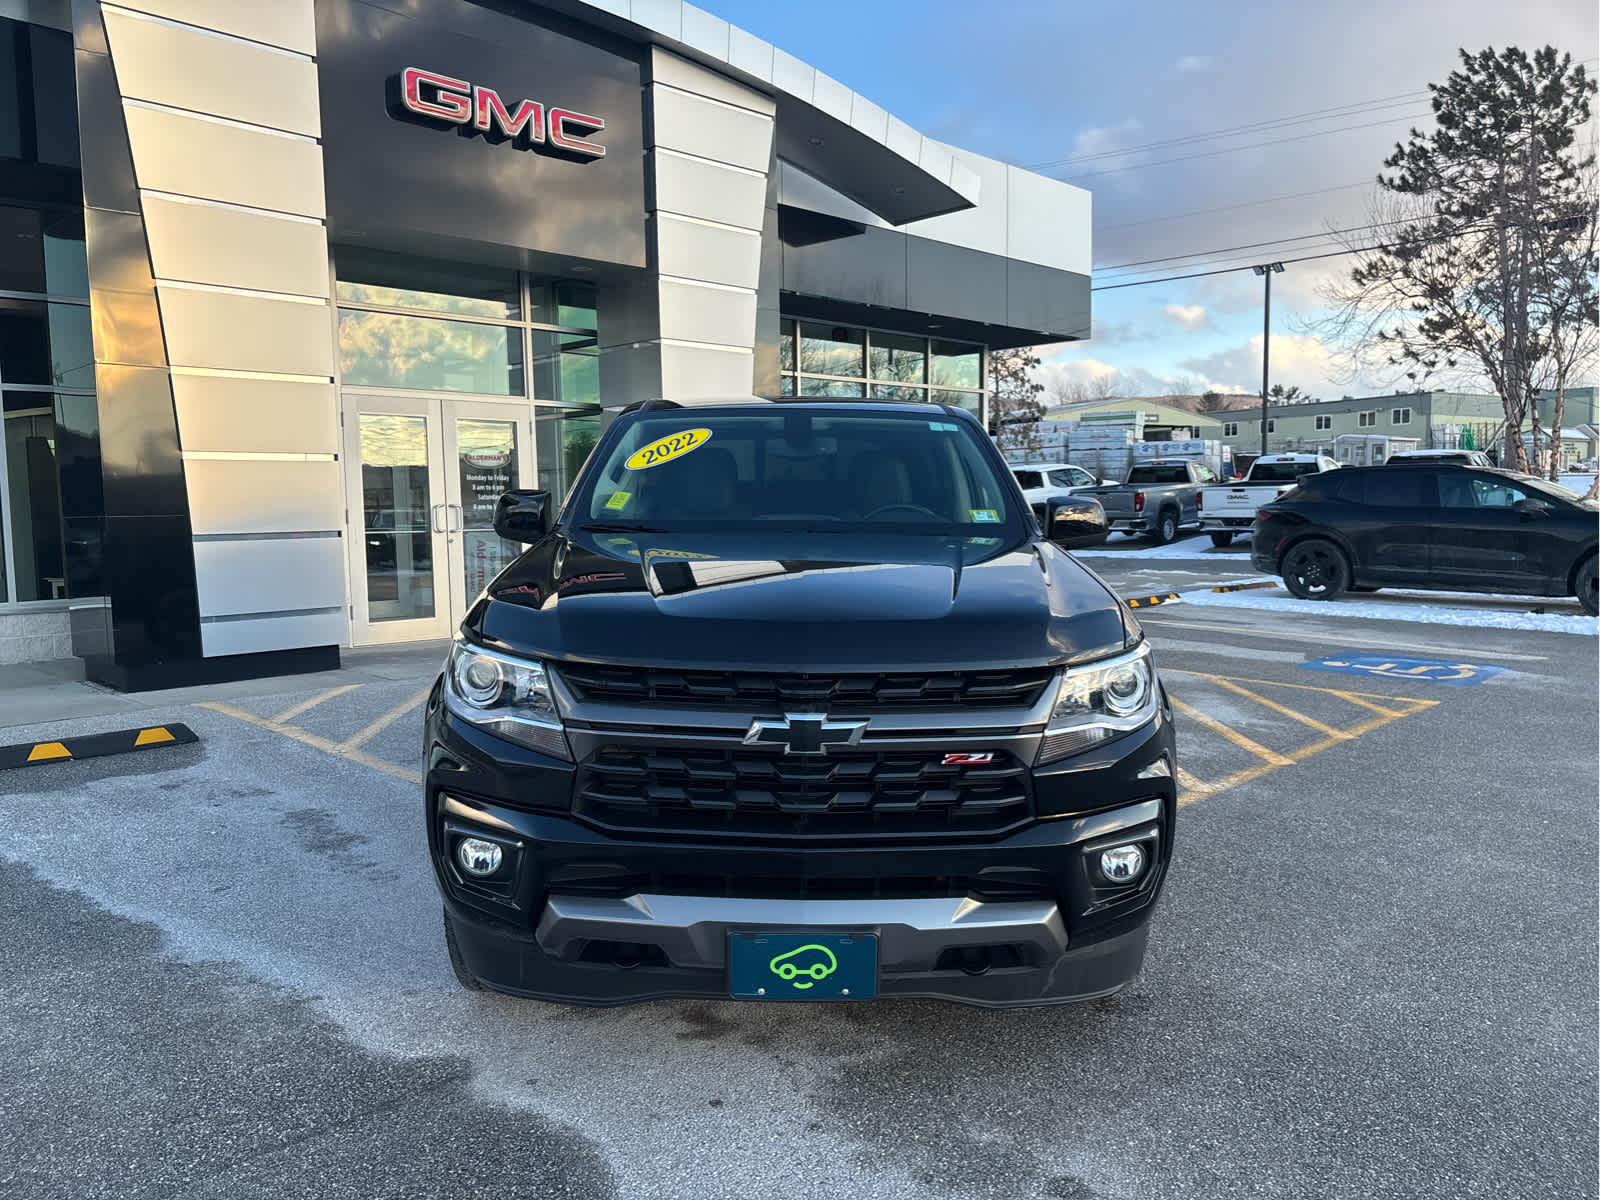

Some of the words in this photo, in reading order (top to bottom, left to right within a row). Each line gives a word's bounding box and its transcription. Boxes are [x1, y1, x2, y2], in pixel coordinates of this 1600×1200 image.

[402, 67, 606, 158] GMC
[642, 433, 698, 464] 2022
[466, 474, 487, 482] Monday
[494, 474, 510, 482] Friday
[477, 540, 486, 593] Alderma
[941, 753, 994, 765] Z71
